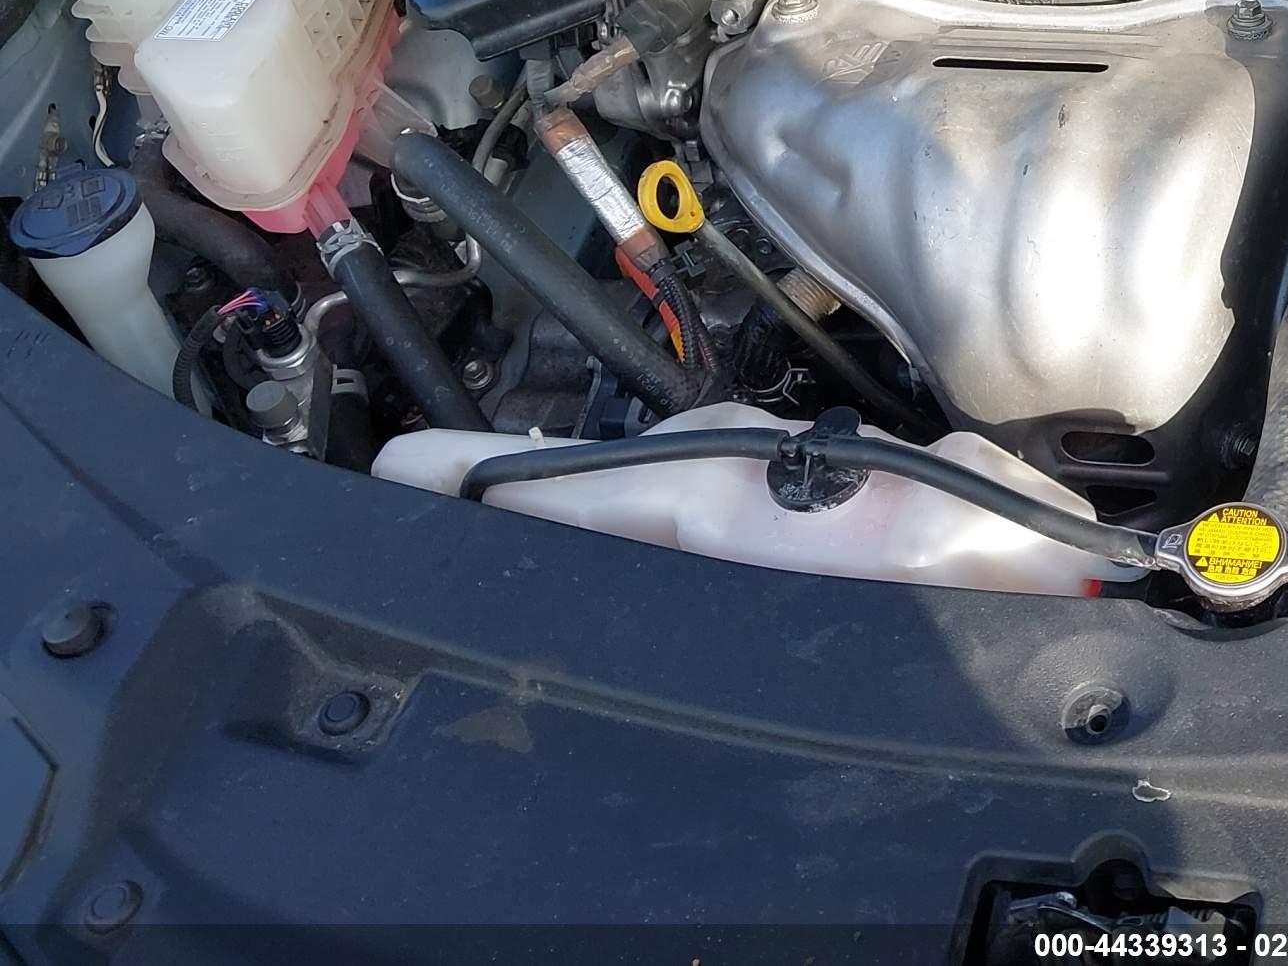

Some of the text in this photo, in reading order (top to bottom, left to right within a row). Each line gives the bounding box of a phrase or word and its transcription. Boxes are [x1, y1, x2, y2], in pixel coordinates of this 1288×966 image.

[1222, 508, 1258, 518] CAUTION
[1220, 516, 1267, 525] ATTENTION
[1209, 558, 1263, 569] ВНИМАНИЕ!
